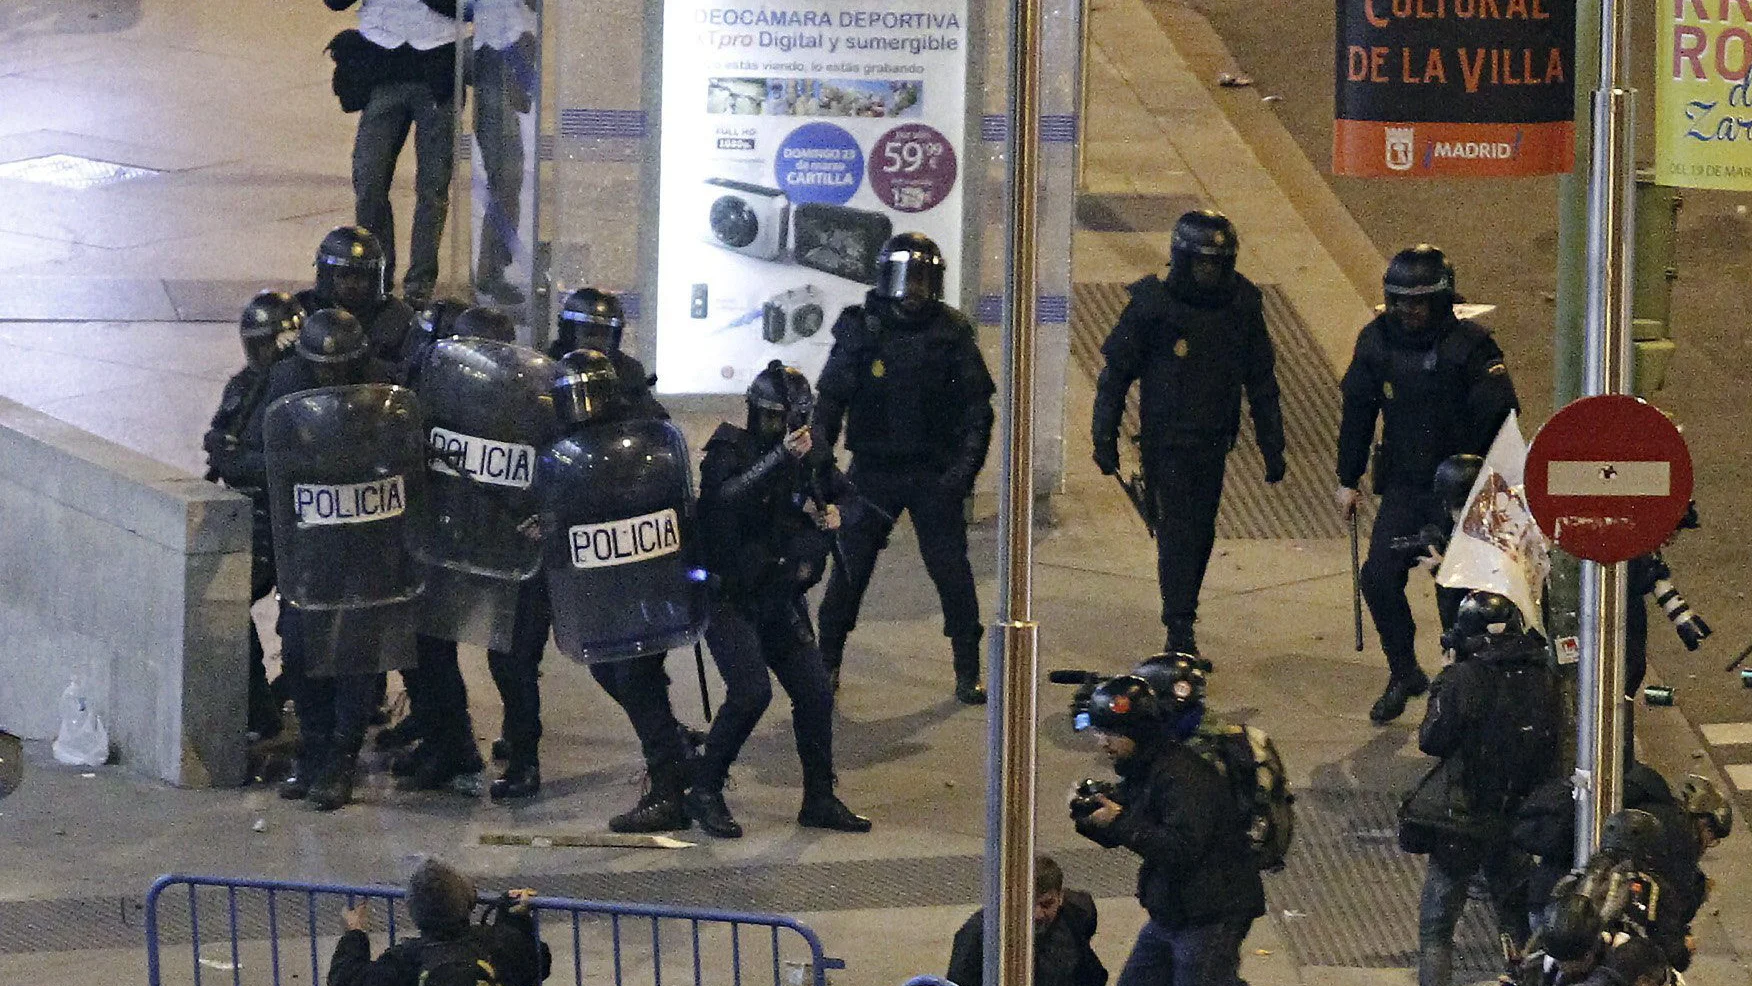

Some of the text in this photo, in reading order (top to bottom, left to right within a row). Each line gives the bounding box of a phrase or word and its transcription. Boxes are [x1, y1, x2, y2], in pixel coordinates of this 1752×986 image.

[840, 11, 960, 29] DEPORTIVA
[759, 31, 823, 52] Digital
[828, 36, 839, 53] y
[846, 34, 958, 54] sumergible
[1347, 45, 1565, 93] DE LA VILLA
[882, 142, 922, 172] 59
[786, 171, 855, 185] CARTILLA
[1706, 165, 1721, 177] DE
[298, 484, 404, 520] POLICIA
[574, 515, 679, 564] POLICIA
